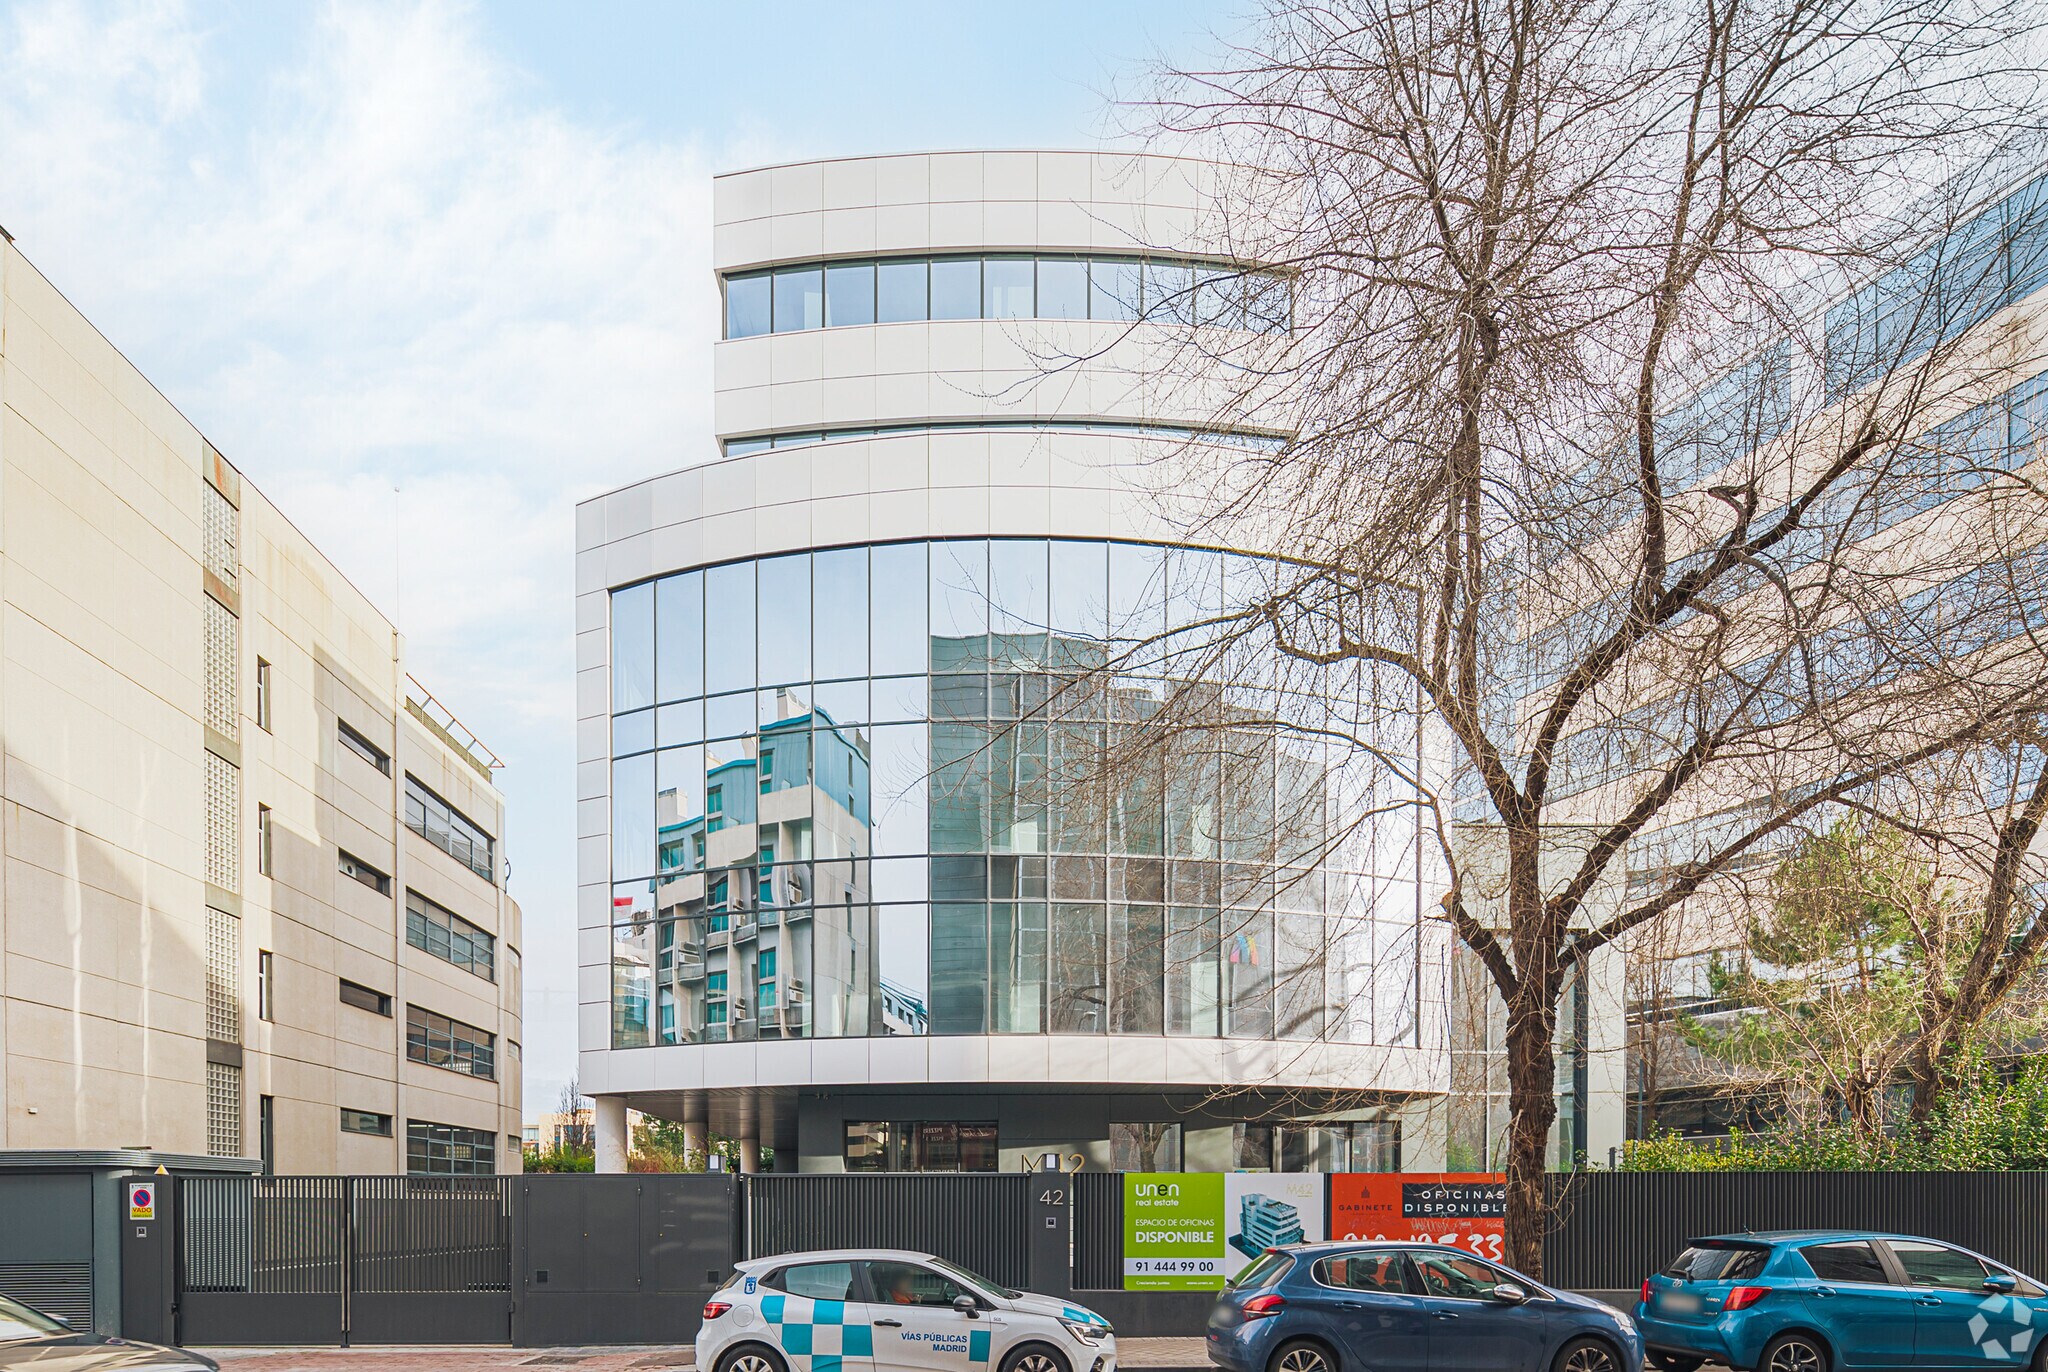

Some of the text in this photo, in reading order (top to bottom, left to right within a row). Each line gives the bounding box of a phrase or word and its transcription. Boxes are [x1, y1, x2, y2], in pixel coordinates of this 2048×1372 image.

[1135, 1184, 1180, 1197] unen
[1421, 1190, 1506, 1200] OFICINAS
[1039, 1189, 1064, 1205] 42
[1135, 1199, 1180, 1207] real estate
[1135, 1218, 1215, 1227] ESPACIO DE OFICINAS
[1135, 1231, 1215, 1243] DISPONIBLE
[1135, 1261, 1214, 1272] 91 444 99 00
[901, 1331, 968, 1343] VÍAS PÚBLICAS
[932, 1344, 967, 1353] MADRID
